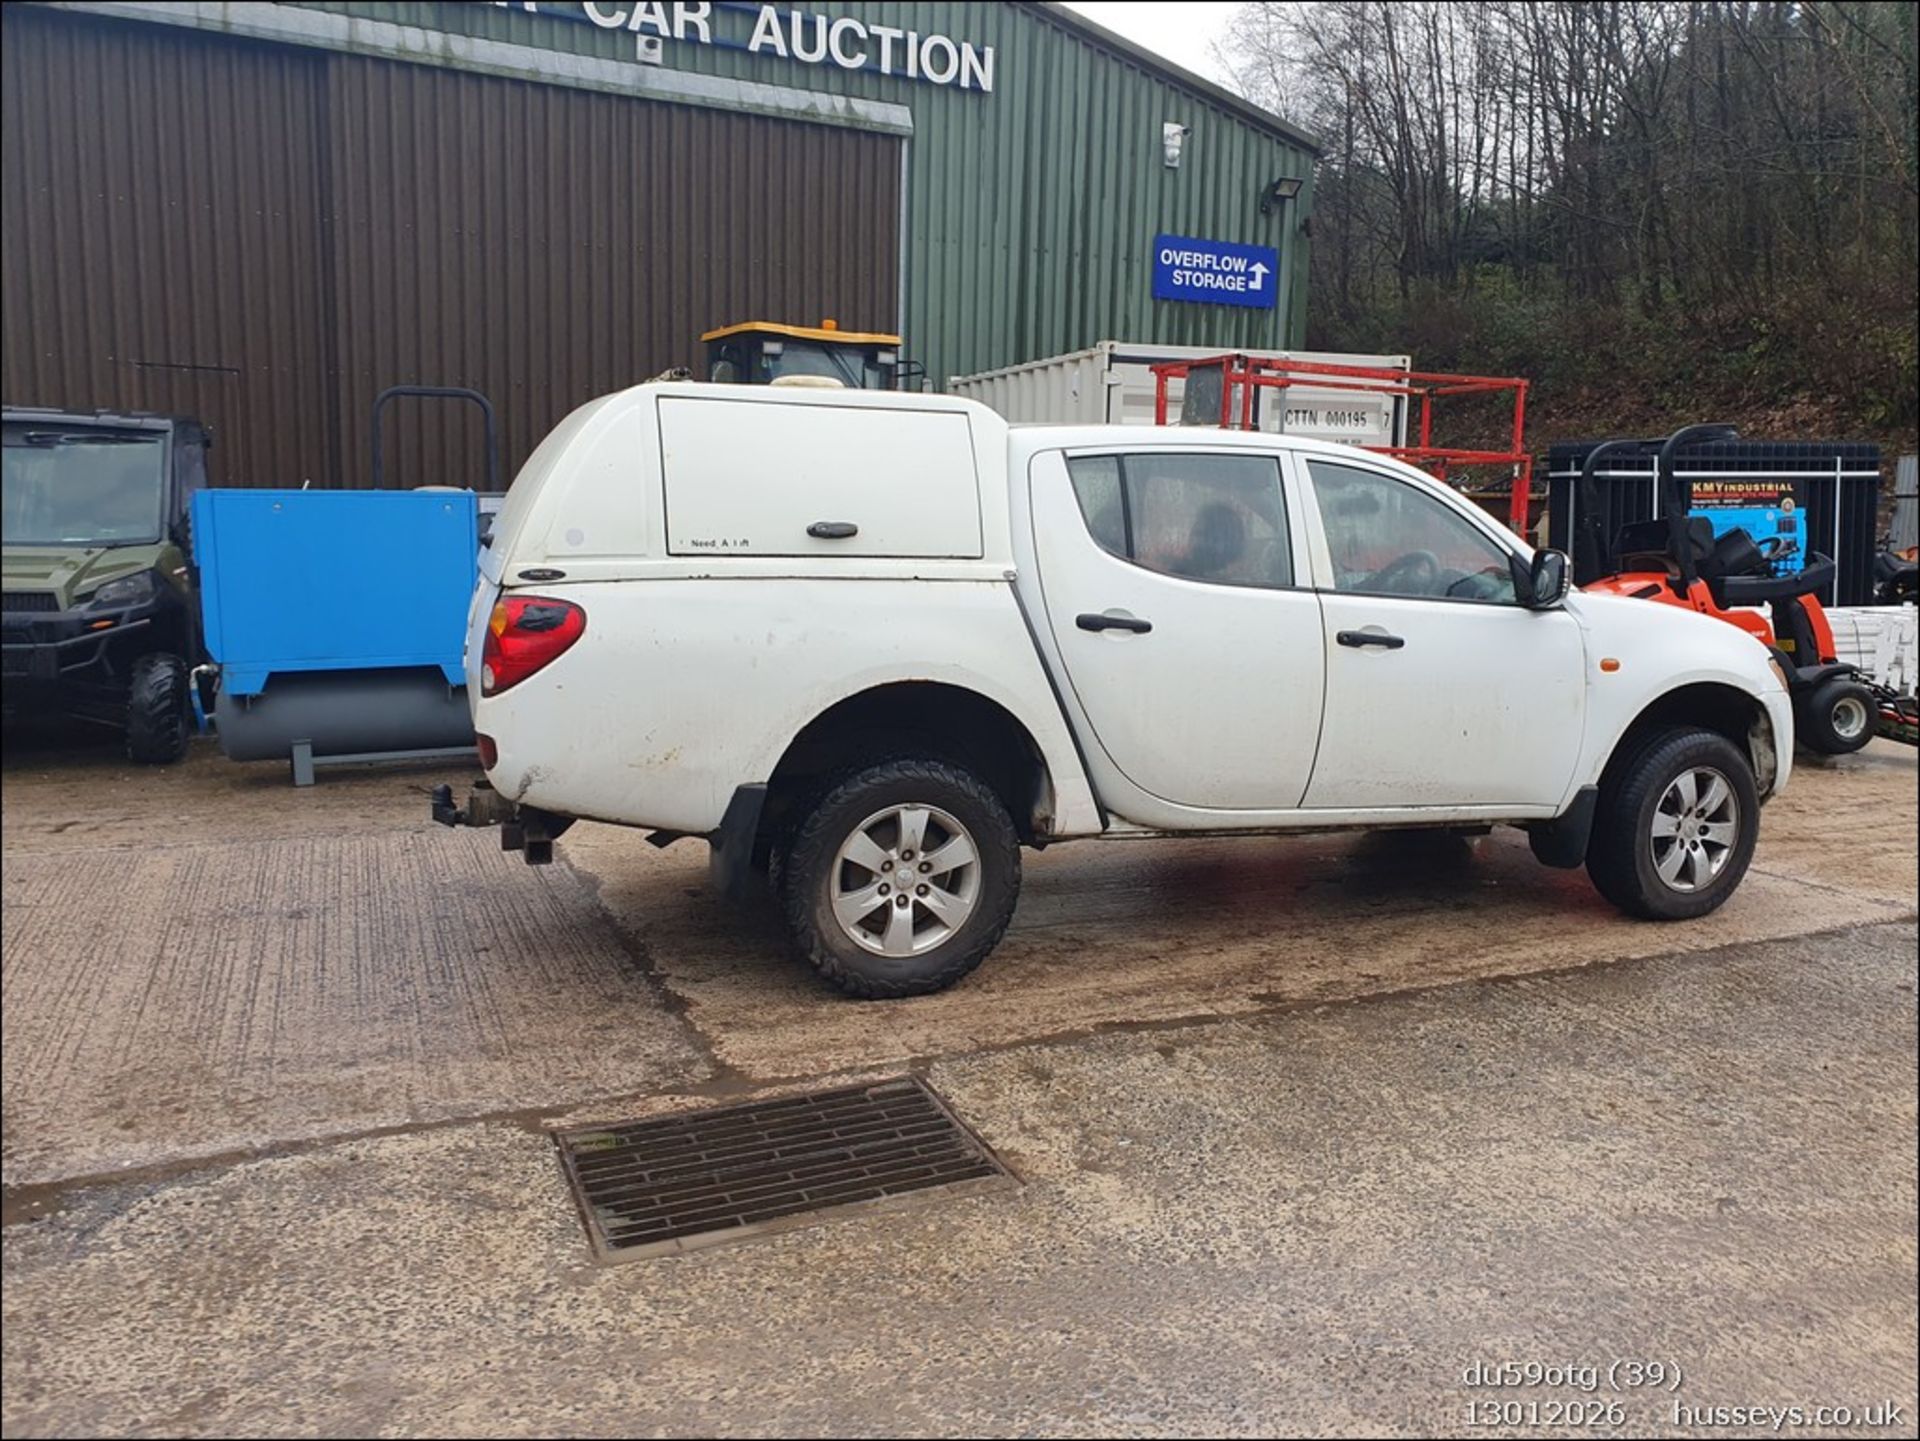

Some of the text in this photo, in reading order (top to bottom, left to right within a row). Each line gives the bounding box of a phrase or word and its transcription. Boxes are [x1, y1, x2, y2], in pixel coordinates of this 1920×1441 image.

[583, 2, 994, 92] CAR AUCTION
[1160, 248, 1247, 273] OVERFLOW
[1172, 269, 1246, 292] STORAGE
[1285, 409, 1390, 427] CTTN 000195 7
[691, 539, 716, 547] Need
[722, 539, 728, 547] A
